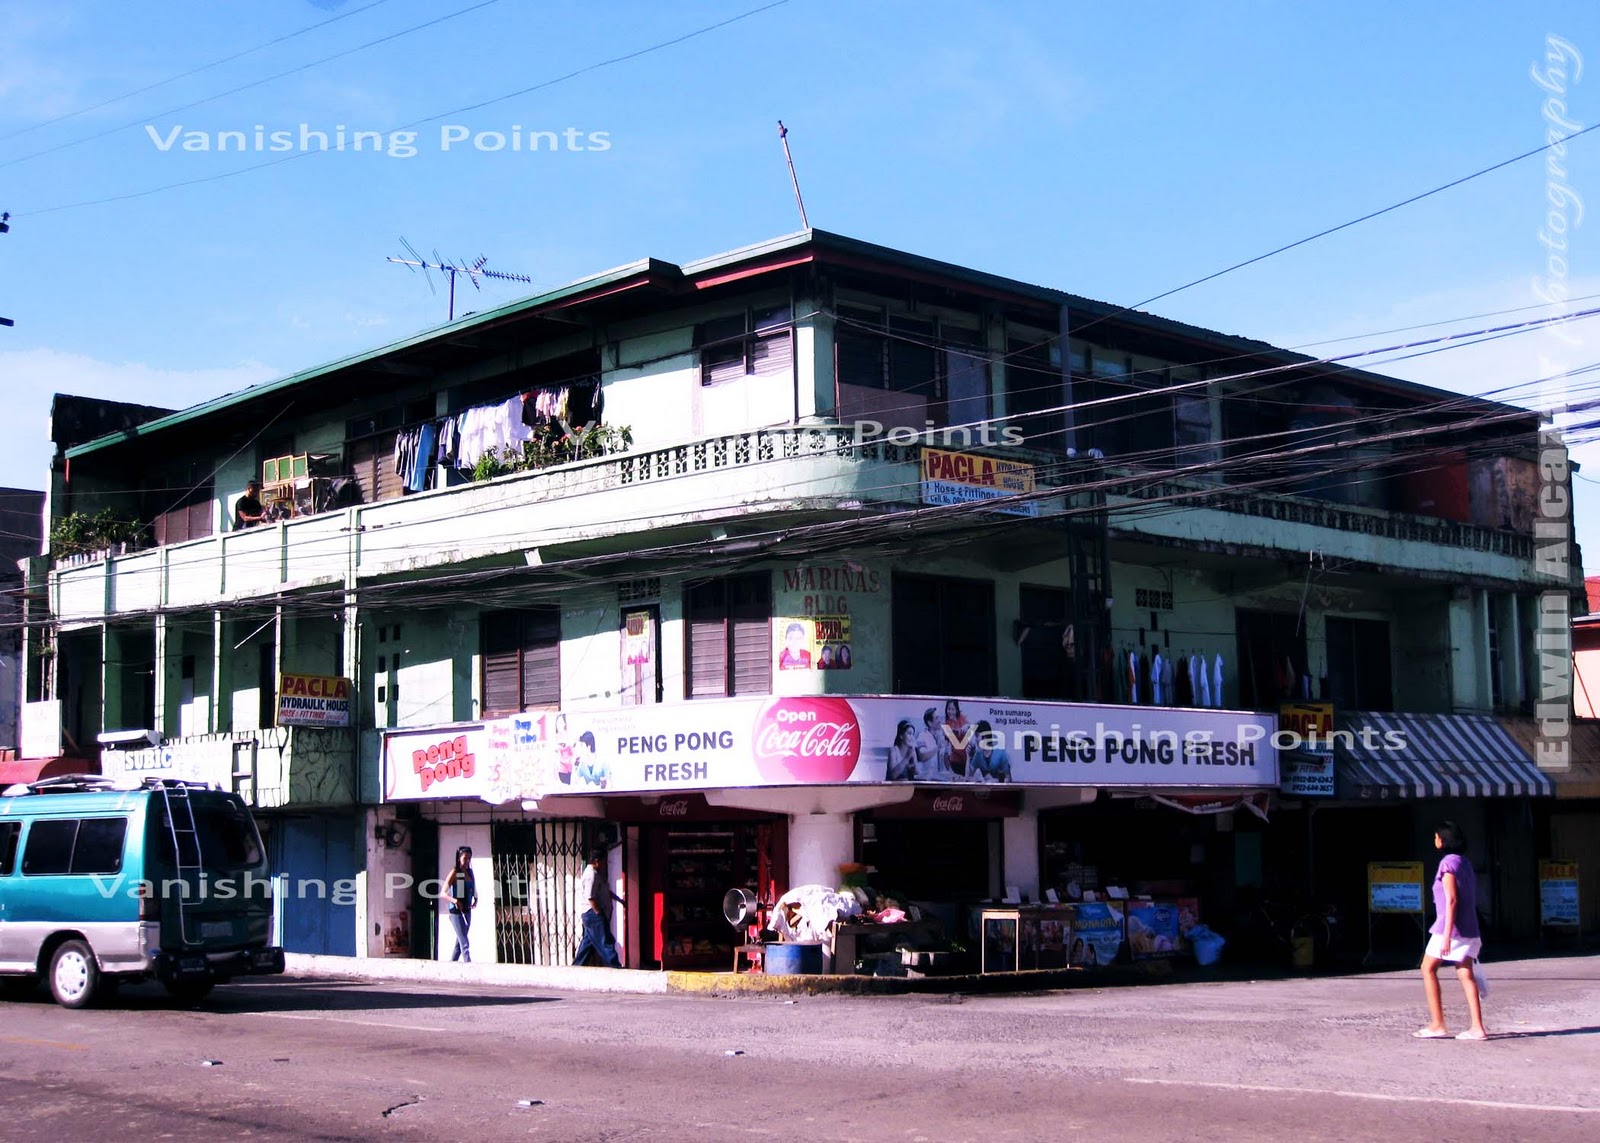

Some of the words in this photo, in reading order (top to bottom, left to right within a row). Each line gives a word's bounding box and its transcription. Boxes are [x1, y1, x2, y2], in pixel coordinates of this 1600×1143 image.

[928, 451, 996, 485] PACLA
[934, 482, 956, 495] Hose
[282, 676, 347, 698] PACLA
[280, 697, 325, 711] HYDRAULIC
[326, 699, 349, 712] HOUSE
[989, 708, 1004, 717] Para
[1005, 709, 1032, 719] sumarap
[776, 709, 817, 724] Open
[995, 718, 1008, 727] ang
[618, 734, 668, 755] PENG
[674, 730, 734, 752] PONG
[756, 722, 856, 758] Coca-Cola
[1024, 735, 1096, 765] PENG
[1105, 738, 1174, 766] PONG
[1182, 740, 1255, 767] FRESH
[125, 747, 173, 771] SUBIC
[412, 735, 467, 774] peng
[420, 753, 476, 792] pong
[644, 761, 708, 782] FRESH
